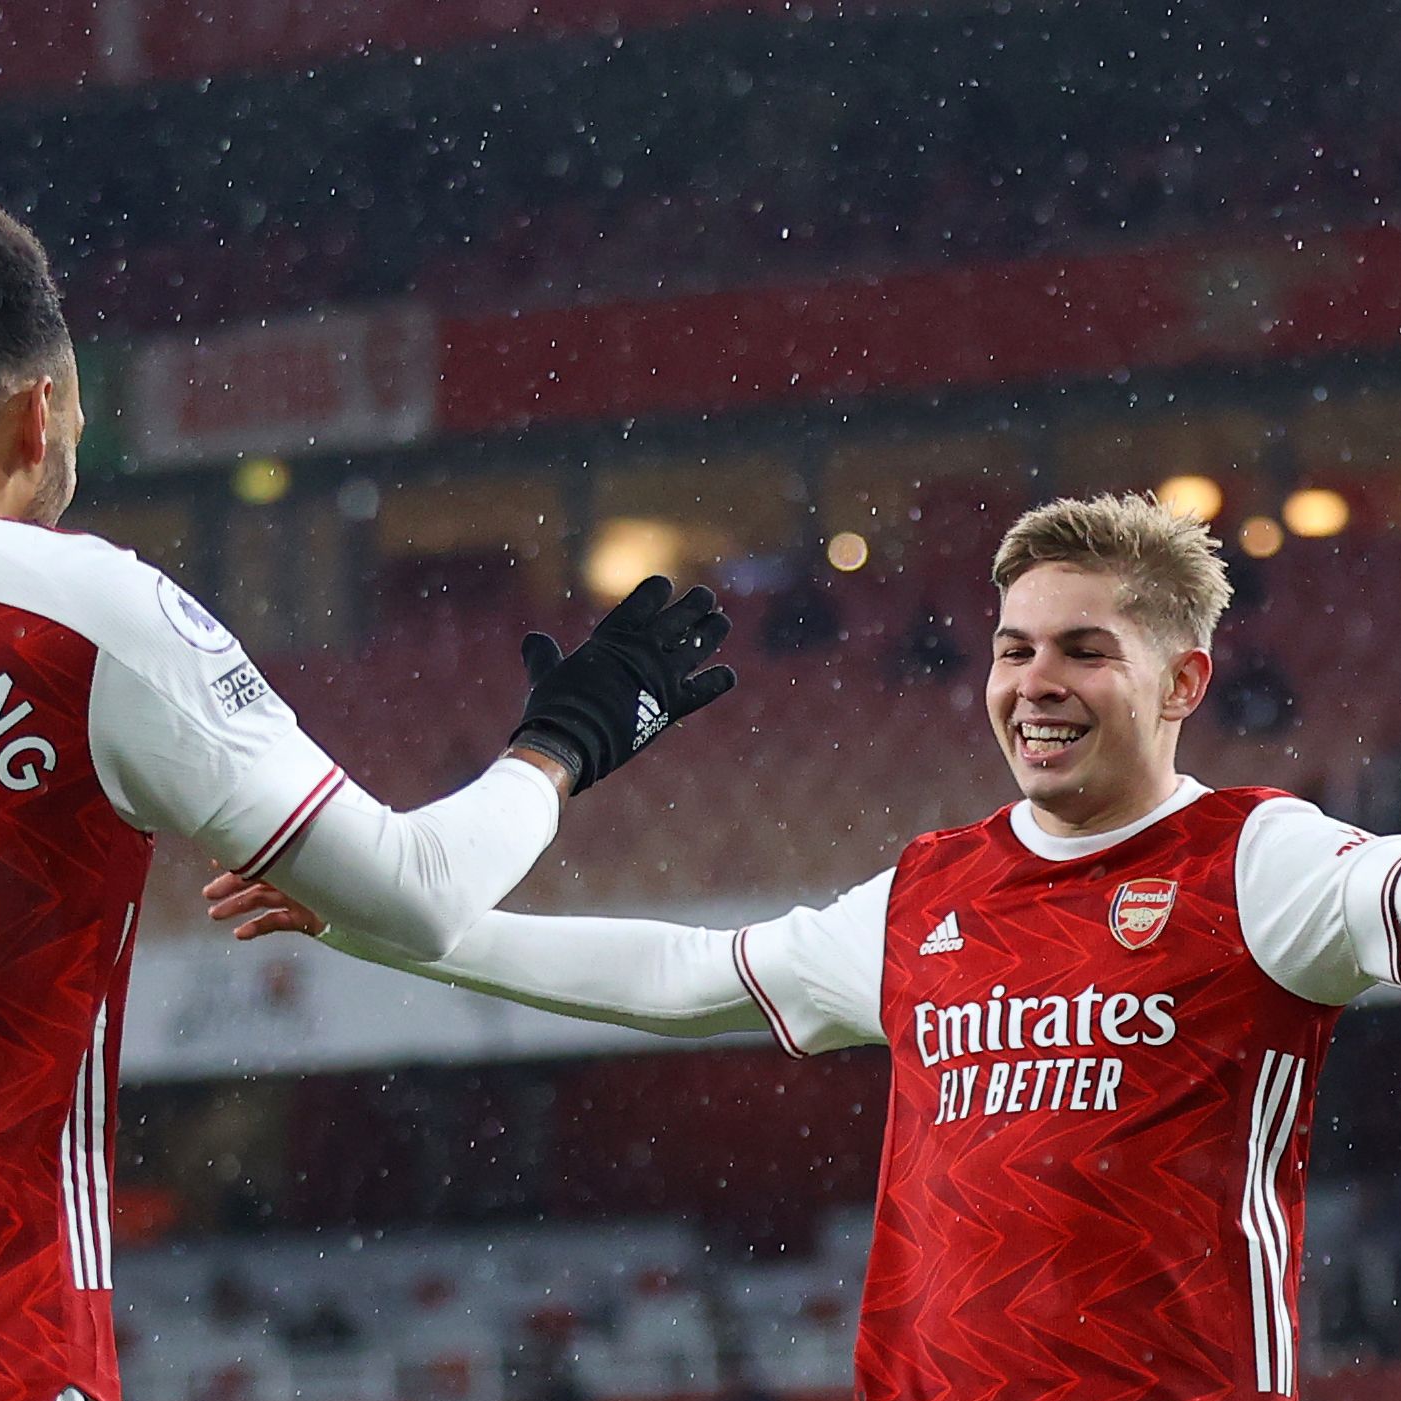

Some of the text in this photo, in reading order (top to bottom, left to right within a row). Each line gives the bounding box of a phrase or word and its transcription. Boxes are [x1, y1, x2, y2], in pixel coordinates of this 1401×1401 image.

[210, 679, 233, 700] No
[1122, 889, 1172, 903] Arsenal
[919, 937, 964, 956] adidas
[914, 983, 1176, 1068] Emirates
[934, 1058, 1123, 1125] FLY BETTER
